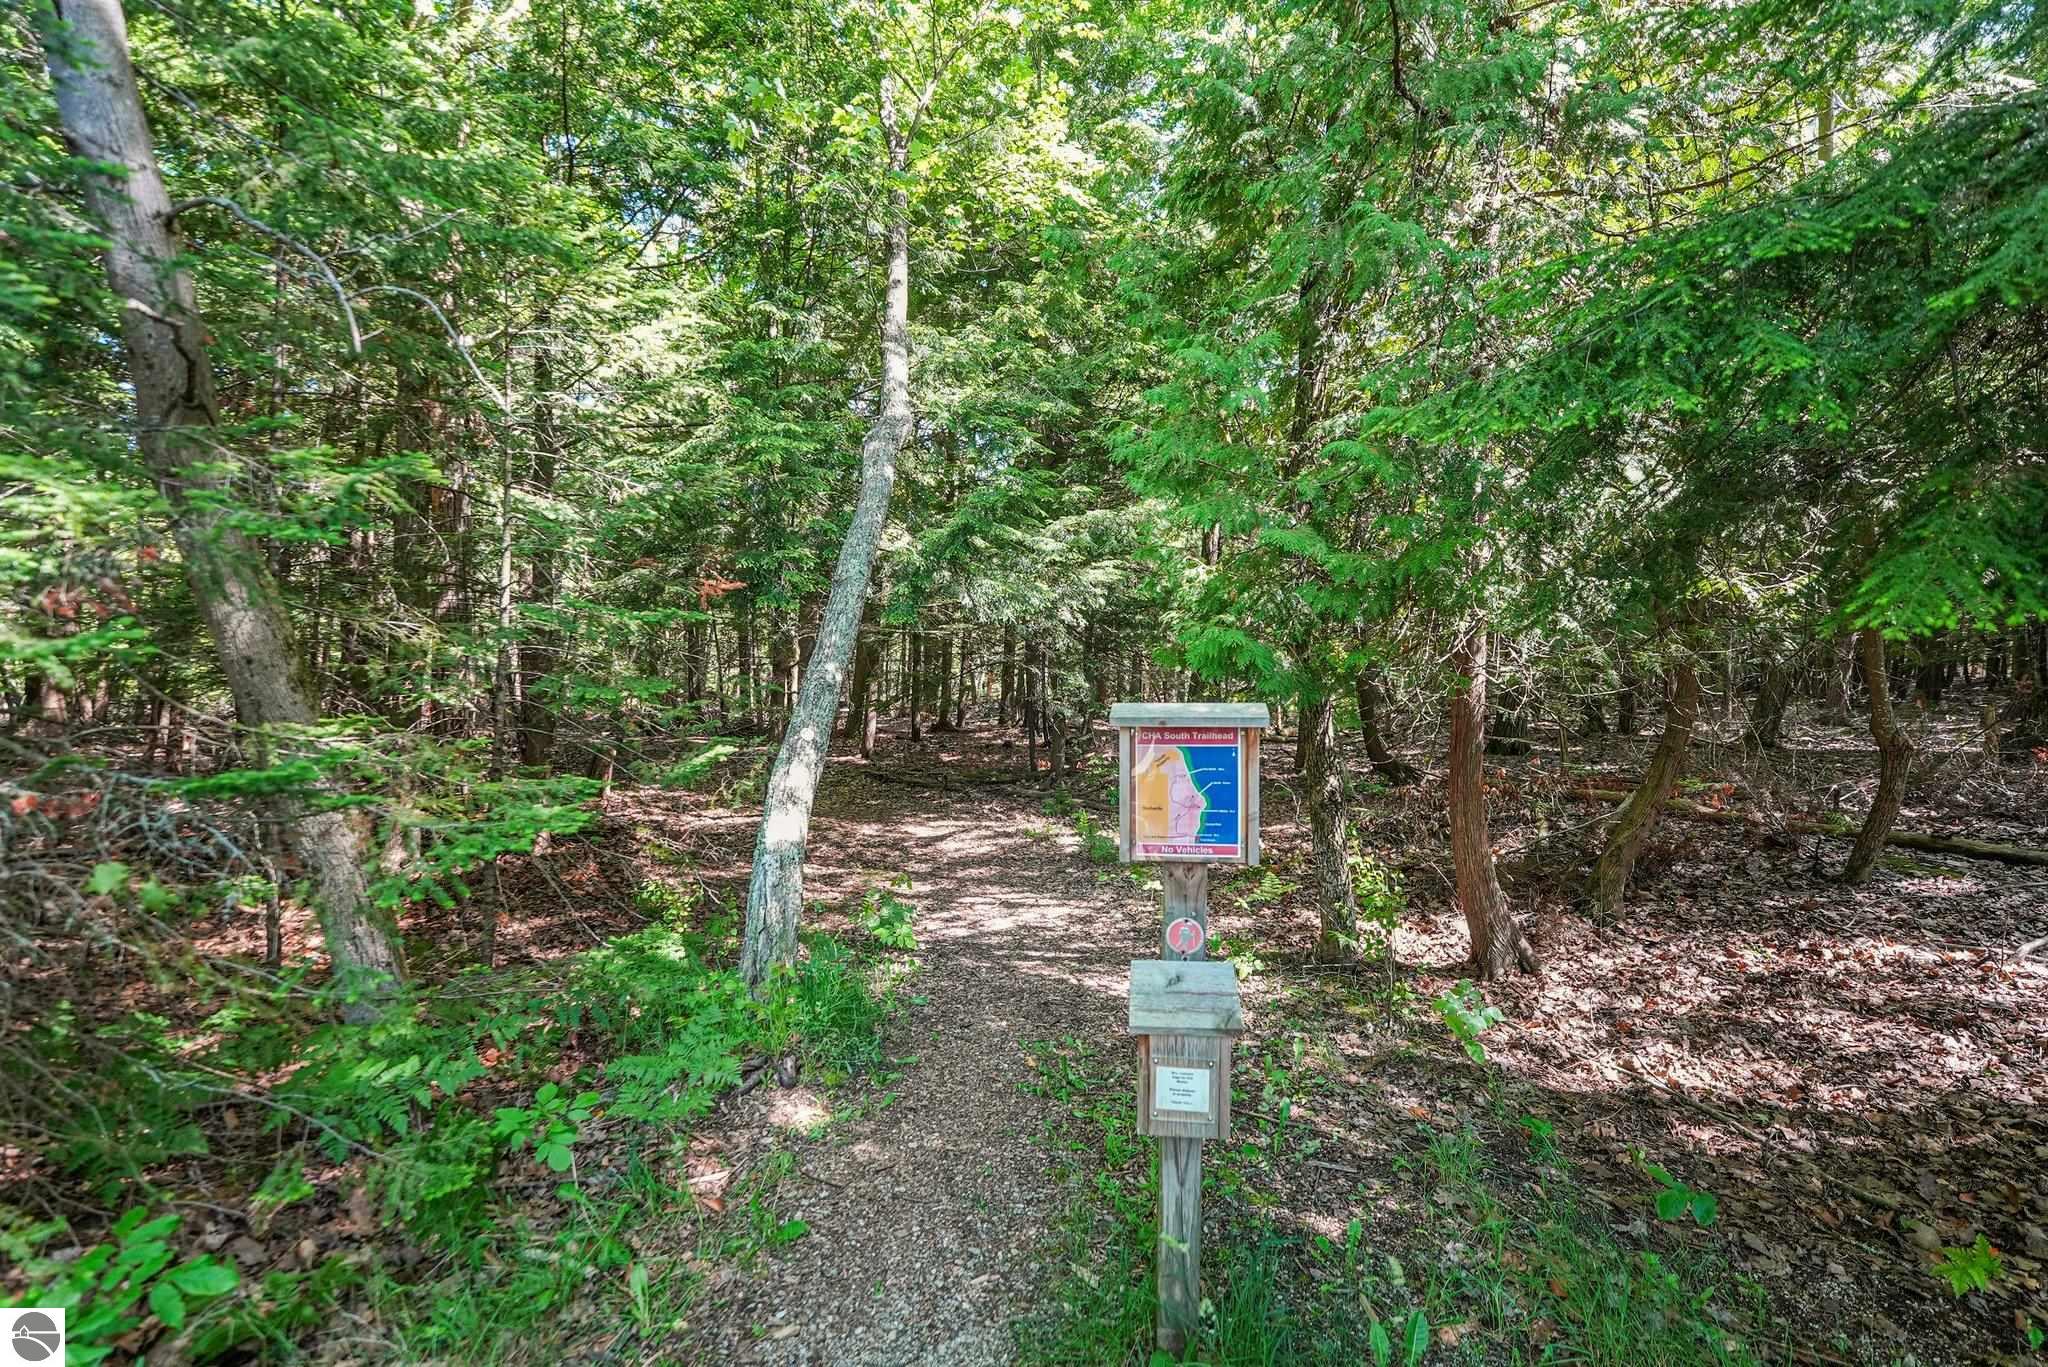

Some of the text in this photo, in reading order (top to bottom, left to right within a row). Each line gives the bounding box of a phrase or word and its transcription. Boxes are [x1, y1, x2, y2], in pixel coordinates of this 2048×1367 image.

[1142, 731, 1234, 740] CHA South Trailhead
[1161, 845, 1214, 854] No Vehicles
